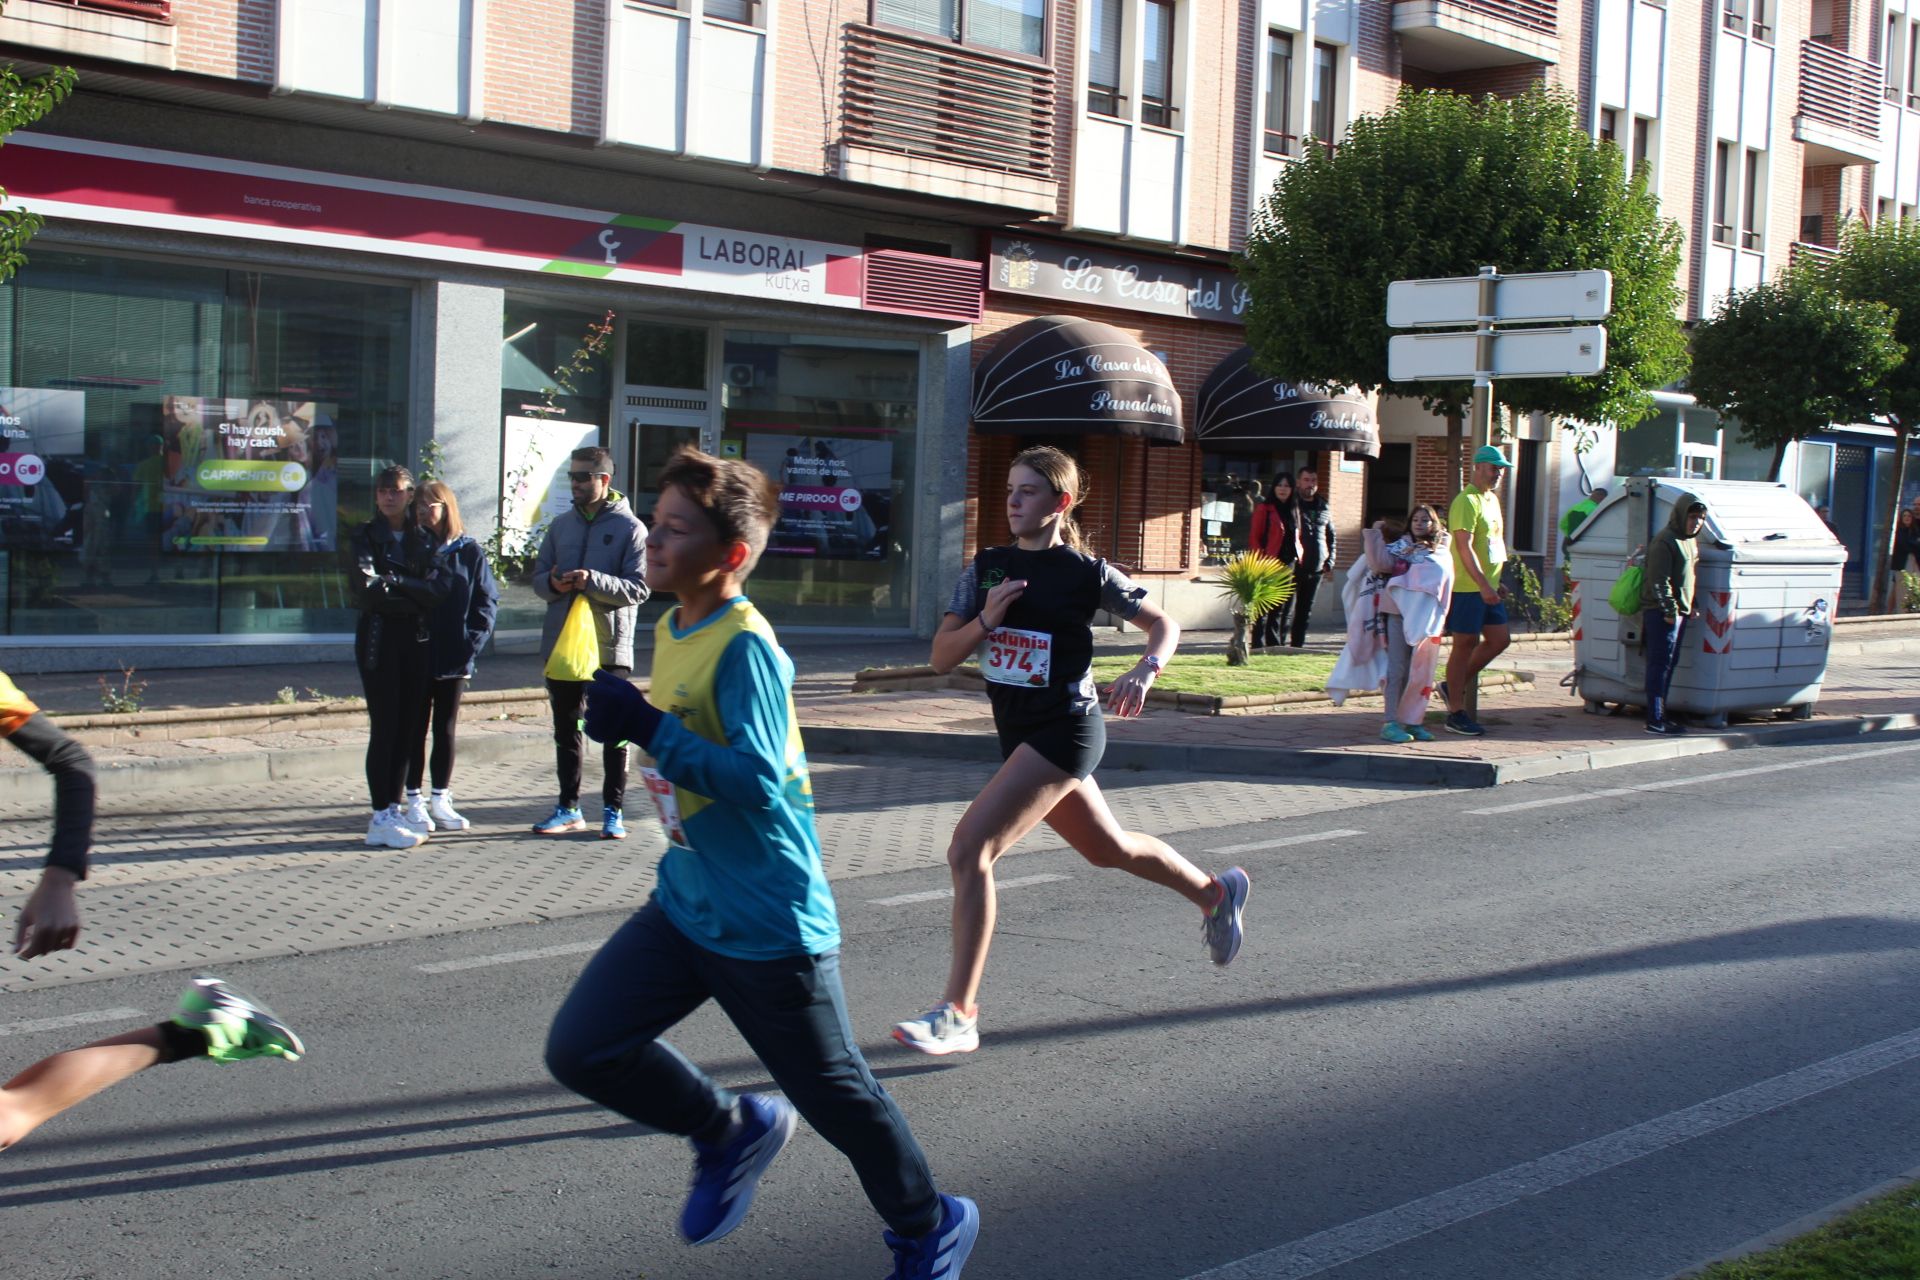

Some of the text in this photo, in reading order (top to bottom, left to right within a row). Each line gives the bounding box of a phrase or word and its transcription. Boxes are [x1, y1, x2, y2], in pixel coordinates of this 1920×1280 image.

[244, 194, 322, 213] banca cooperativa
[700, 236, 810, 273] LABORAL
[765, 272, 810, 292] kutxa
[1062, 256, 1102, 293] La
[1112, 265, 1181, 305] Casa
[1188, 278, 1222, 311] del
[1055, 359, 1085, 381] La
[1086, 354, 1132, 372] Casa
[1133, 357, 1153, 375] del
[1273, 383, 1298, 401] La
[3, 428, 29, 439] una.
[232, 424, 251, 436] hay
[254, 426, 287, 437] crush,
[227, 437, 278, 449] hay cash.
[793, 456, 846, 467] Mundo, nos
[200, 469, 277, 482] CAPRICHITO
[787, 466, 851, 477] vamos de una.
[779, 492, 794, 501] ME
[796, 493, 836, 503] PIROOO
[986, 631, 1048, 650] edunia
[989, 646, 1033, 672] 374
